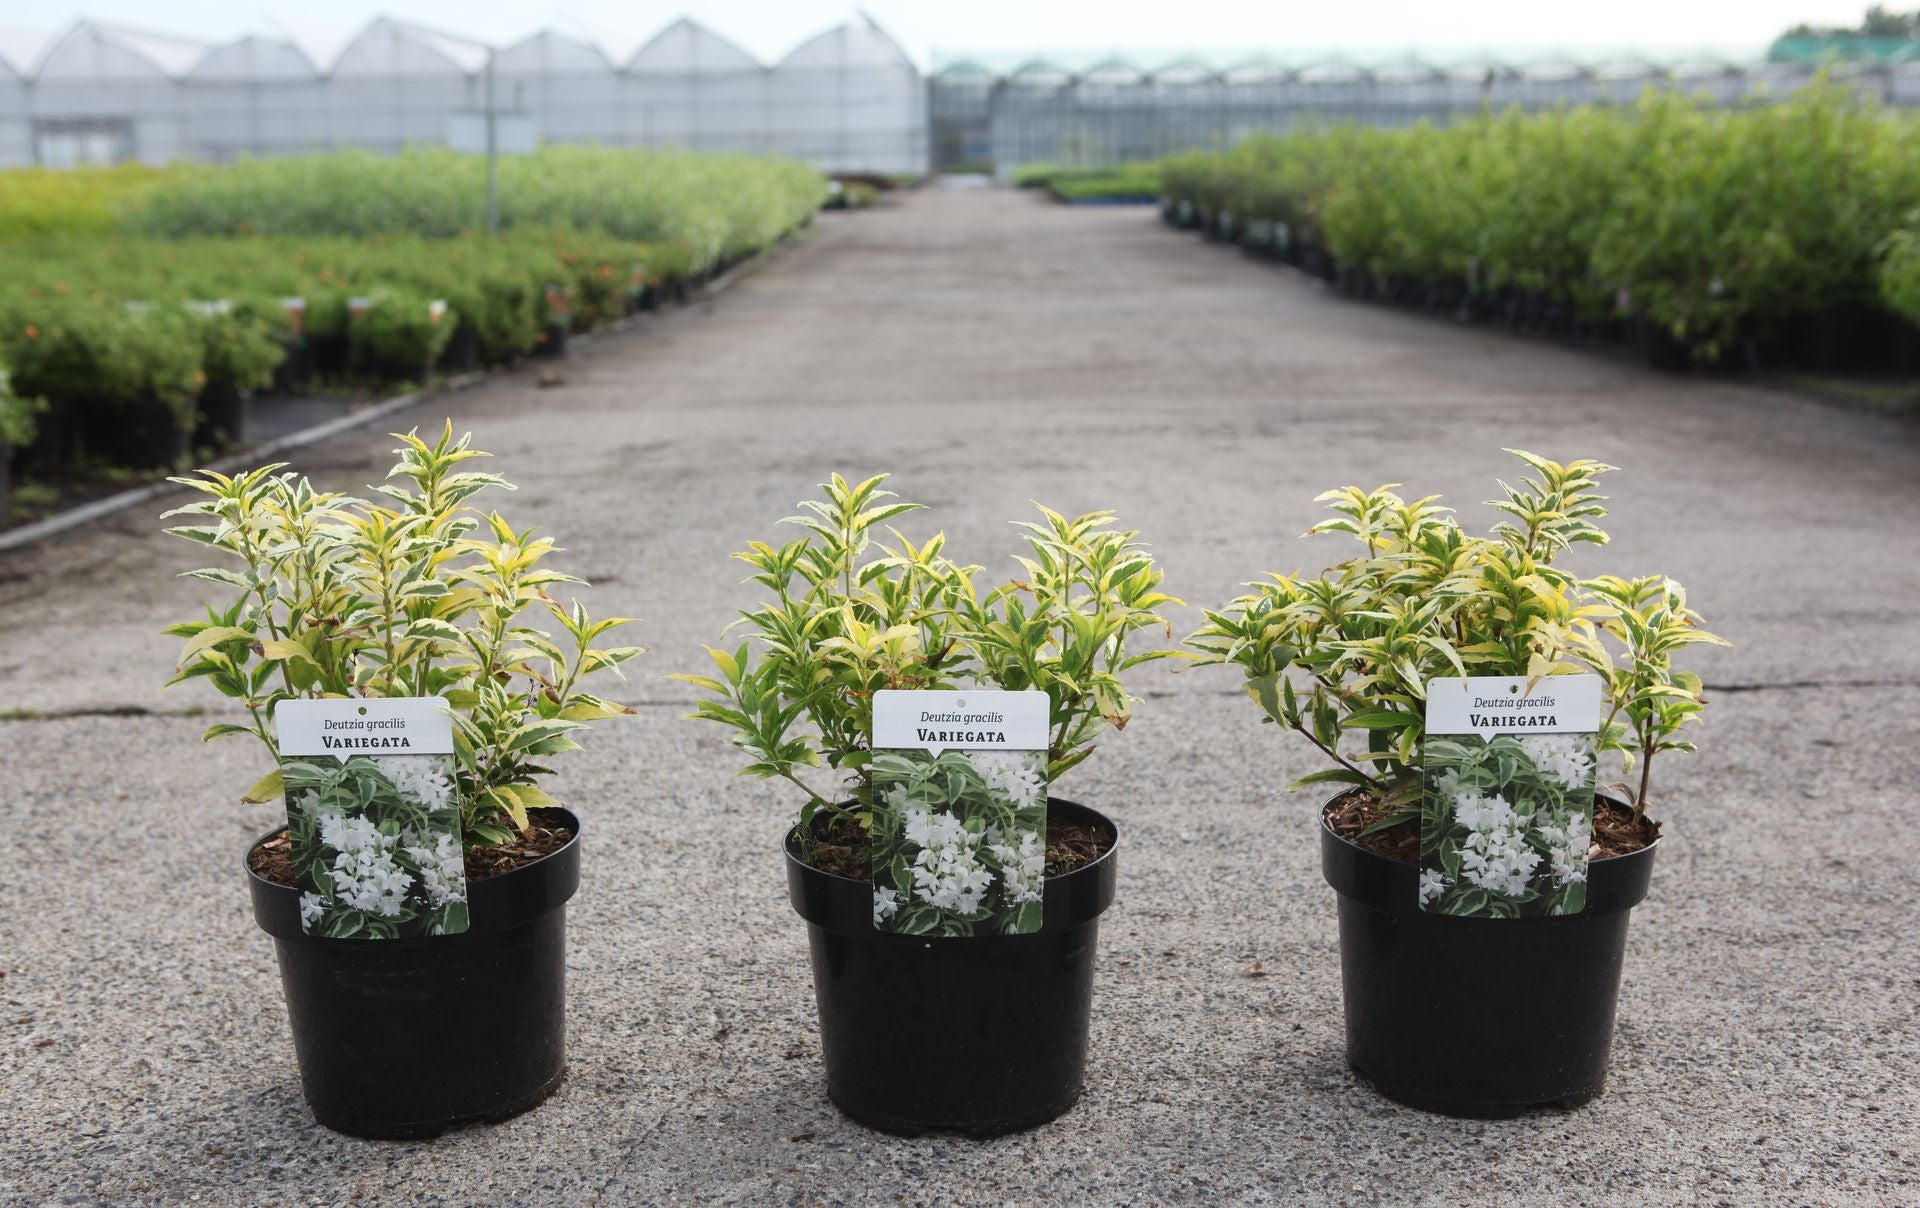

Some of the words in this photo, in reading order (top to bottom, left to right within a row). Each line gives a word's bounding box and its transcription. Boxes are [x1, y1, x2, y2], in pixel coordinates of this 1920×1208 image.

[1474, 697, 1515, 709] Deutzia
[1516, 697, 1556, 710] gracilis
[324, 718, 364, 730] Deutzia
[366, 717, 406, 732] gracilis
[921, 711, 962, 723] Deutzia
[963, 711, 1004, 725] gracilis
[1470, 714, 1558, 728] VARIEGATA
[321, 735, 411, 749] VARIEGATA
[916, 728, 1006, 743] VARIEGATA
